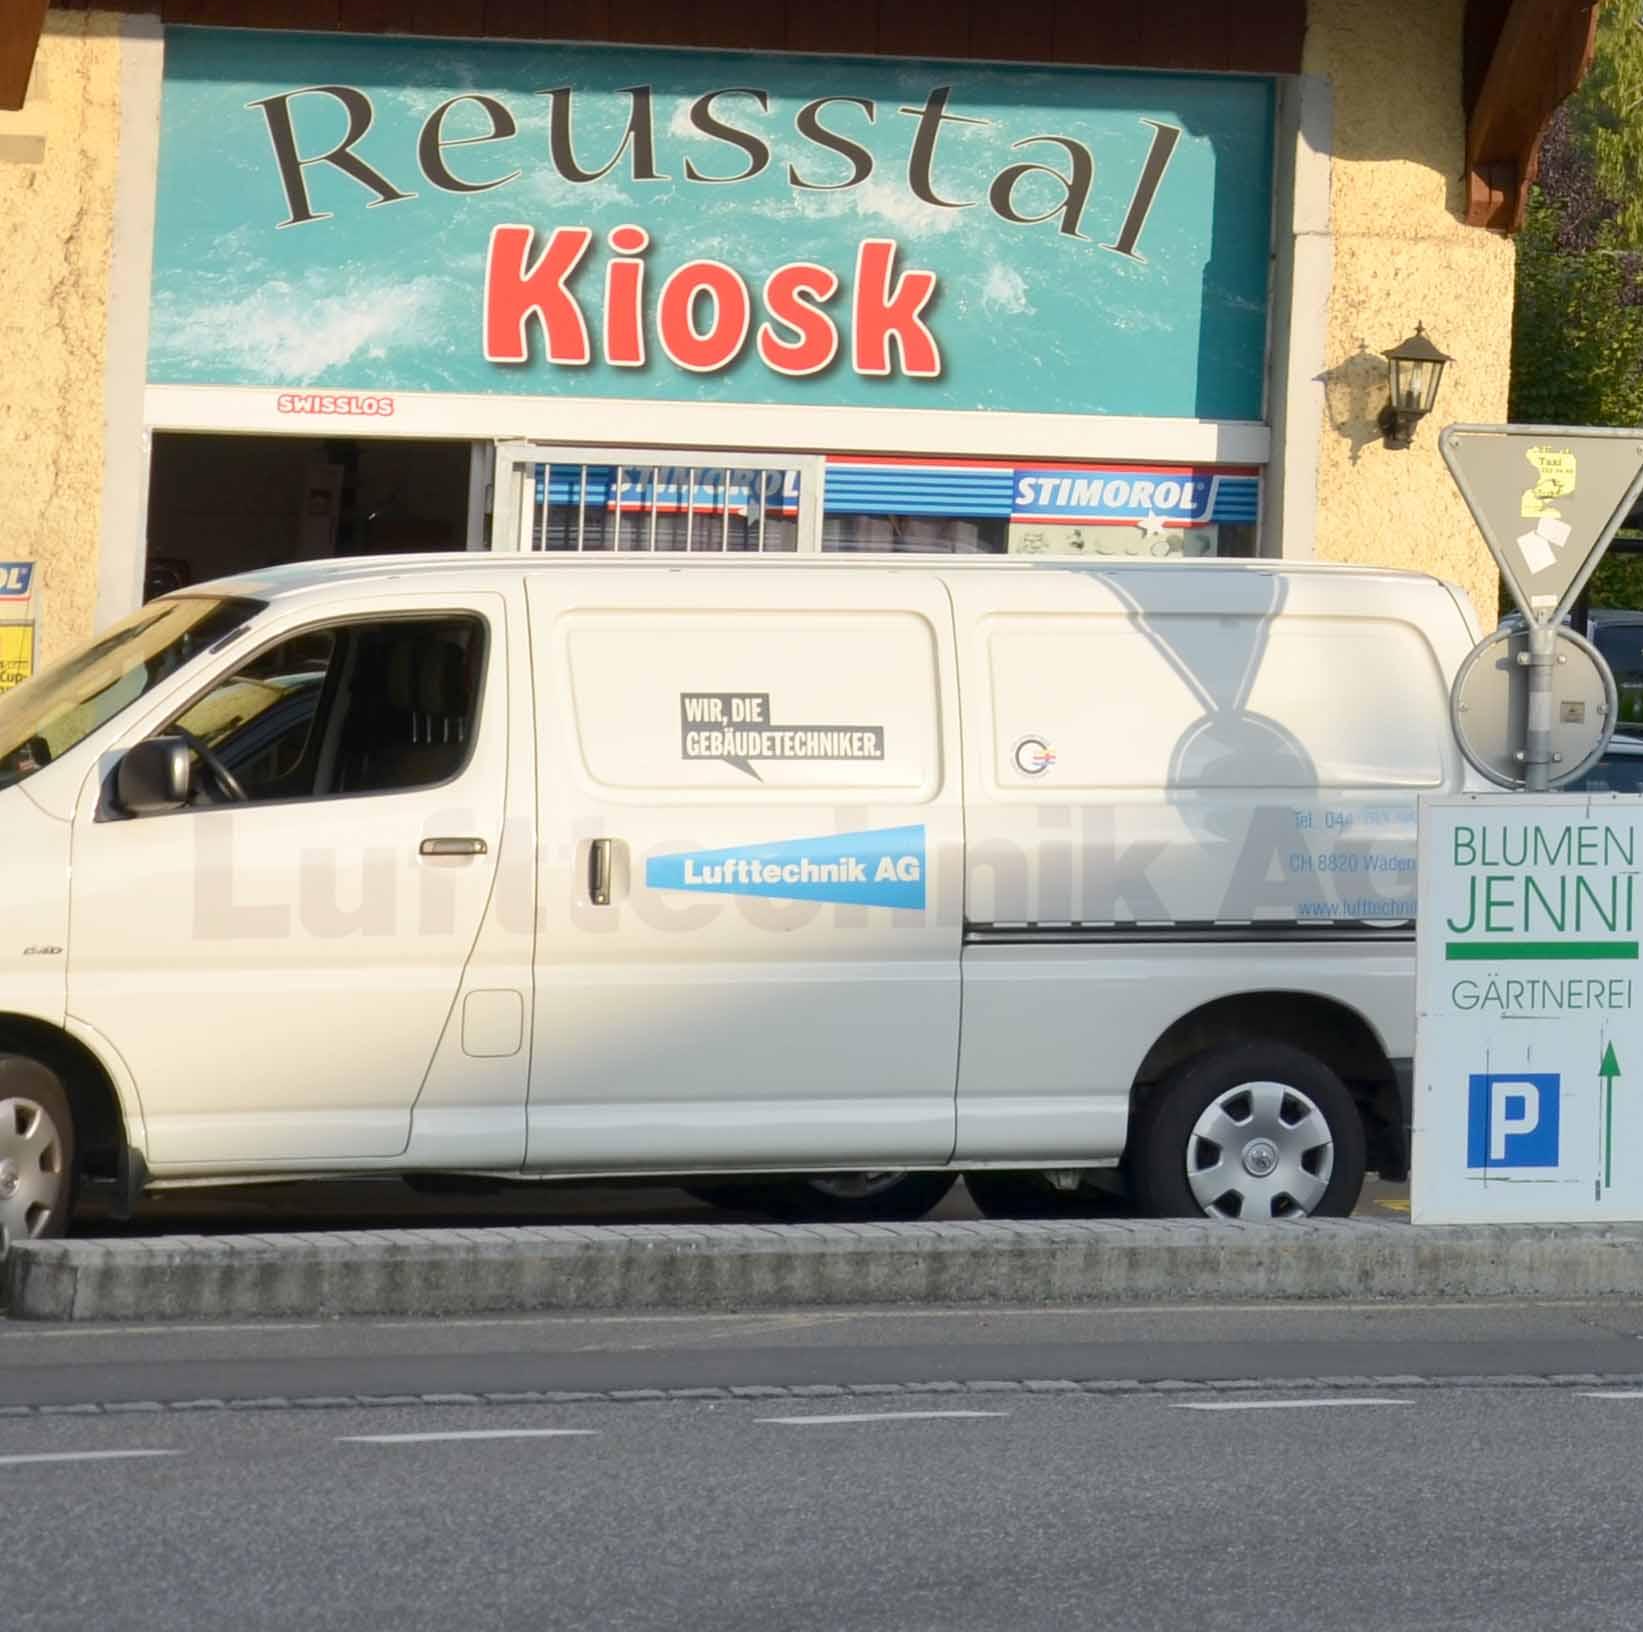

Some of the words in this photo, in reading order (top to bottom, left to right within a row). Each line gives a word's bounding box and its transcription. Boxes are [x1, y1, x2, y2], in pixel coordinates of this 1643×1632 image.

[246, 82, 1184, 264] Reusstal
[482, 223, 942, 379] Kiosk
[277, 394, 396, 417] SWISSLOS
[1015, 475, 1198, 511] STIMOROL
[684, 697, 728, 726] WIR,
[731, 697, 763, 722] DIE
[686, 727, 881, 756] GEBÄUDETECHNIKER.
[1317, 853, 1358, 872] 8820
[1453, 825, 1634, 867] BLUMEN
[684, 857, 867, 885] Lufttechnik
[873, 855, 920, 882] AG
[1446, 874, 1634, 934] JENNI
[1451, 972, 1632, 1010] GÄRTNEREI
[1490, 1081, 1540, 1160] P
